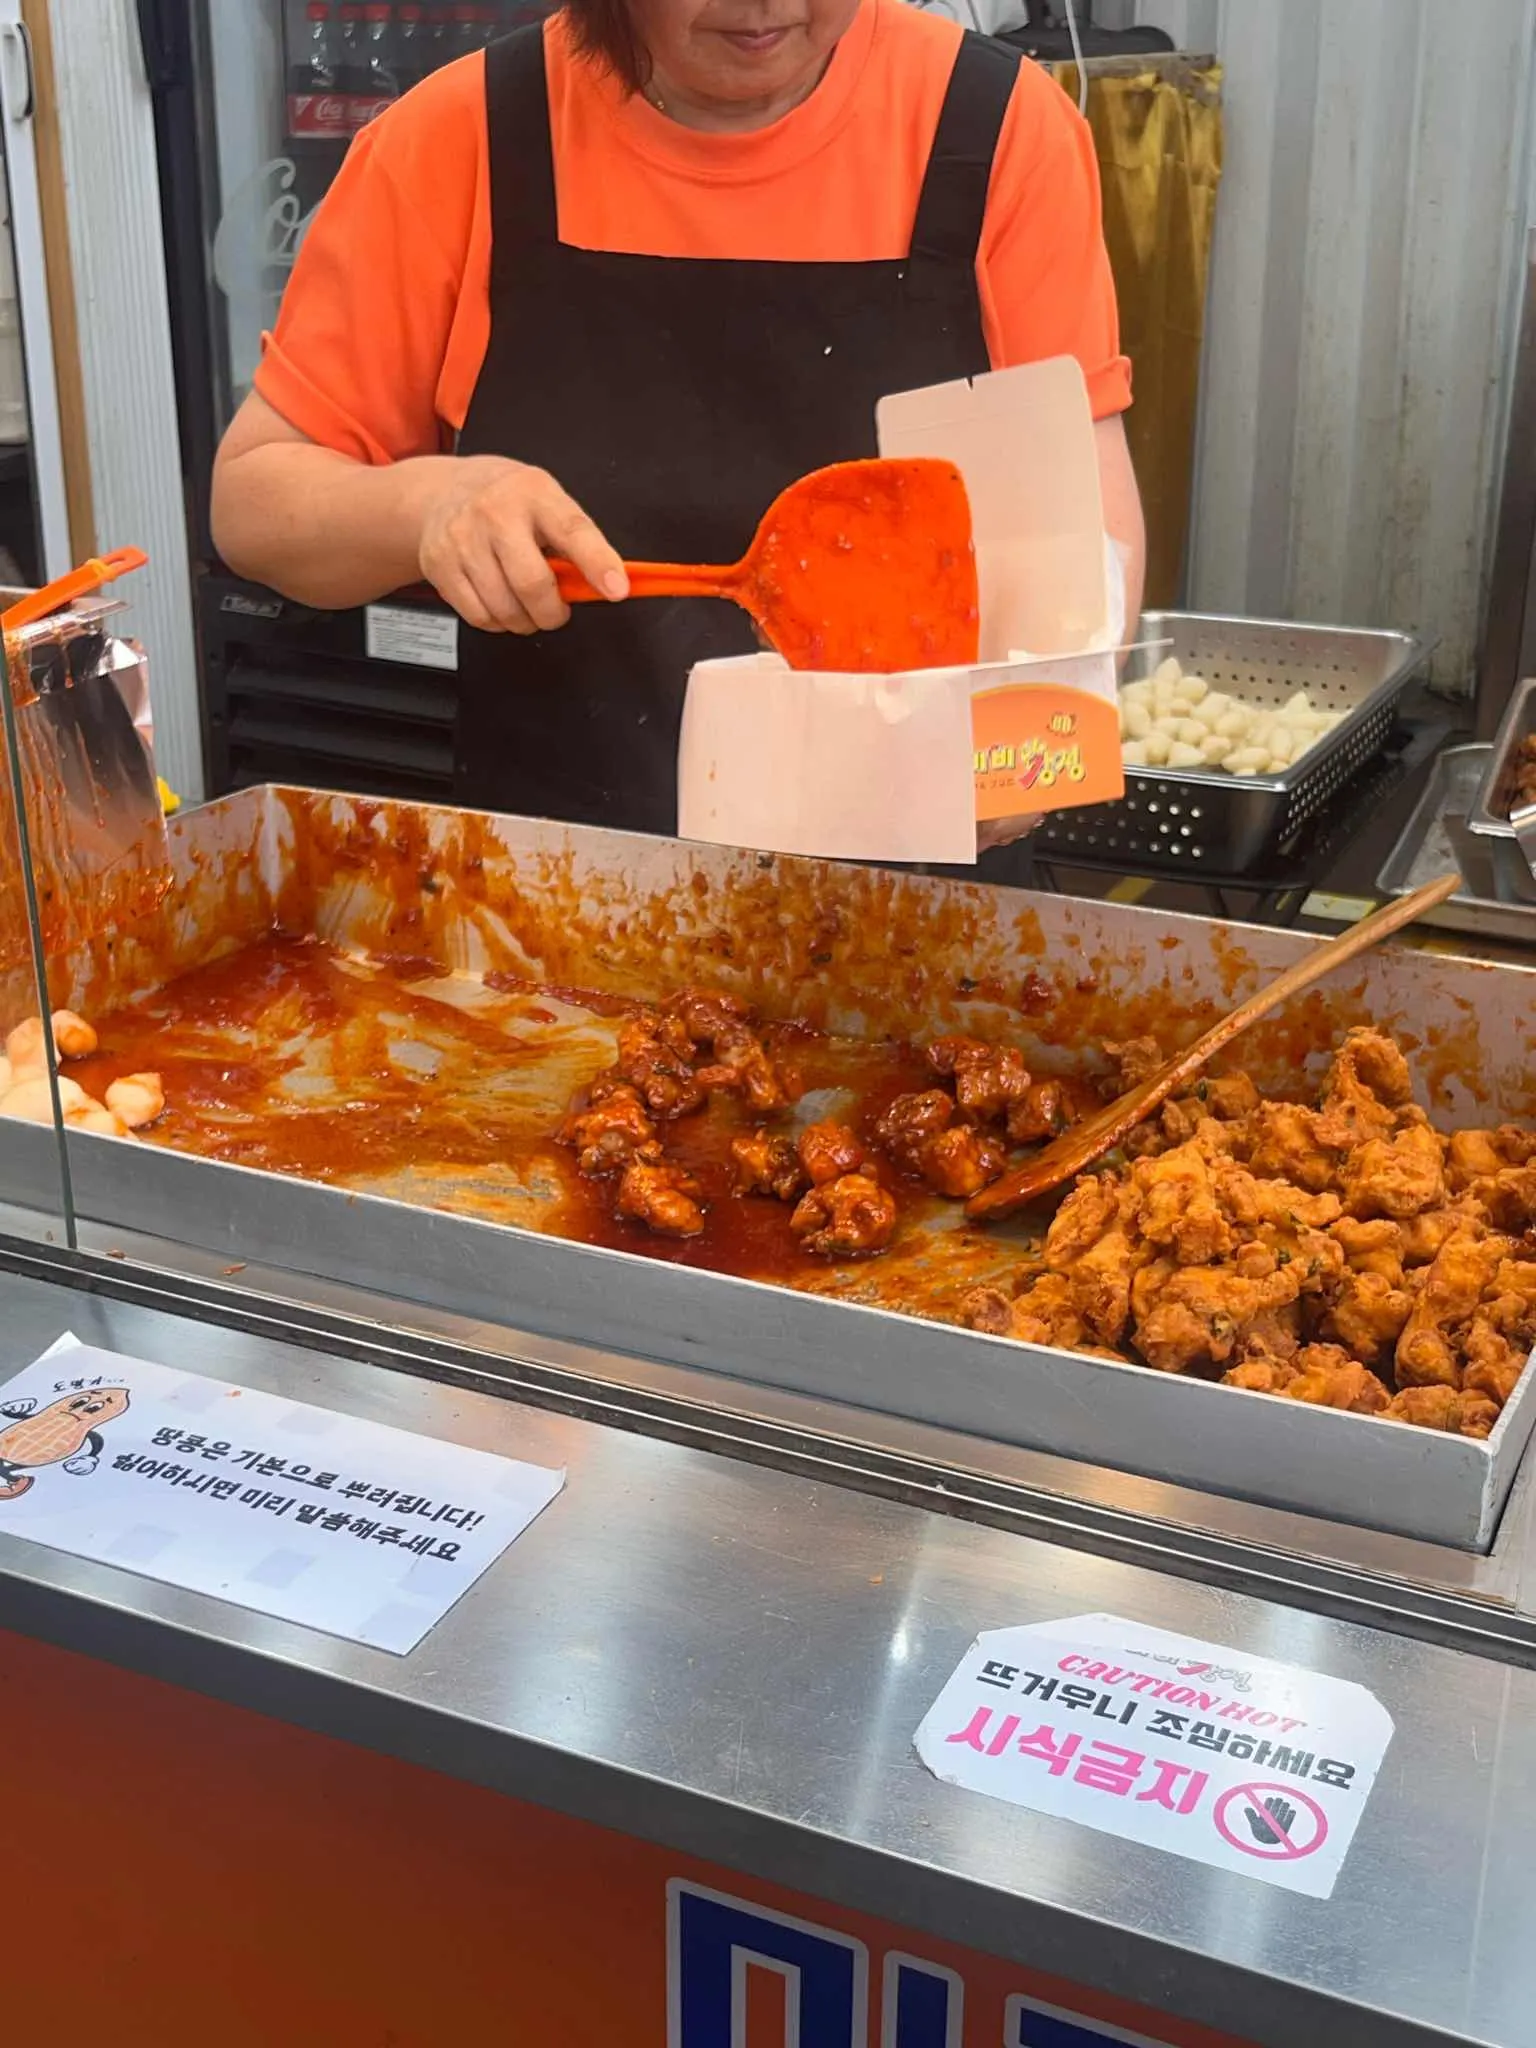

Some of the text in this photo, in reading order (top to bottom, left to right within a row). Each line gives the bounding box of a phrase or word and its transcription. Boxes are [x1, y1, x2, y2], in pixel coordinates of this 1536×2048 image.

[111, 1452, 462, 1562] 싫어하시면 미리 말씀해주세요
[151, 1427, 486, 1532] 땅콩은 기본으로 뿌려집니다!
[976, 1660, 1356, 1791] 뜨거우니 조심하세요
[1057, 1653, 1308, 1733] CAUTION HOT
[944, 1706, 1210, 1815] 시식금지
